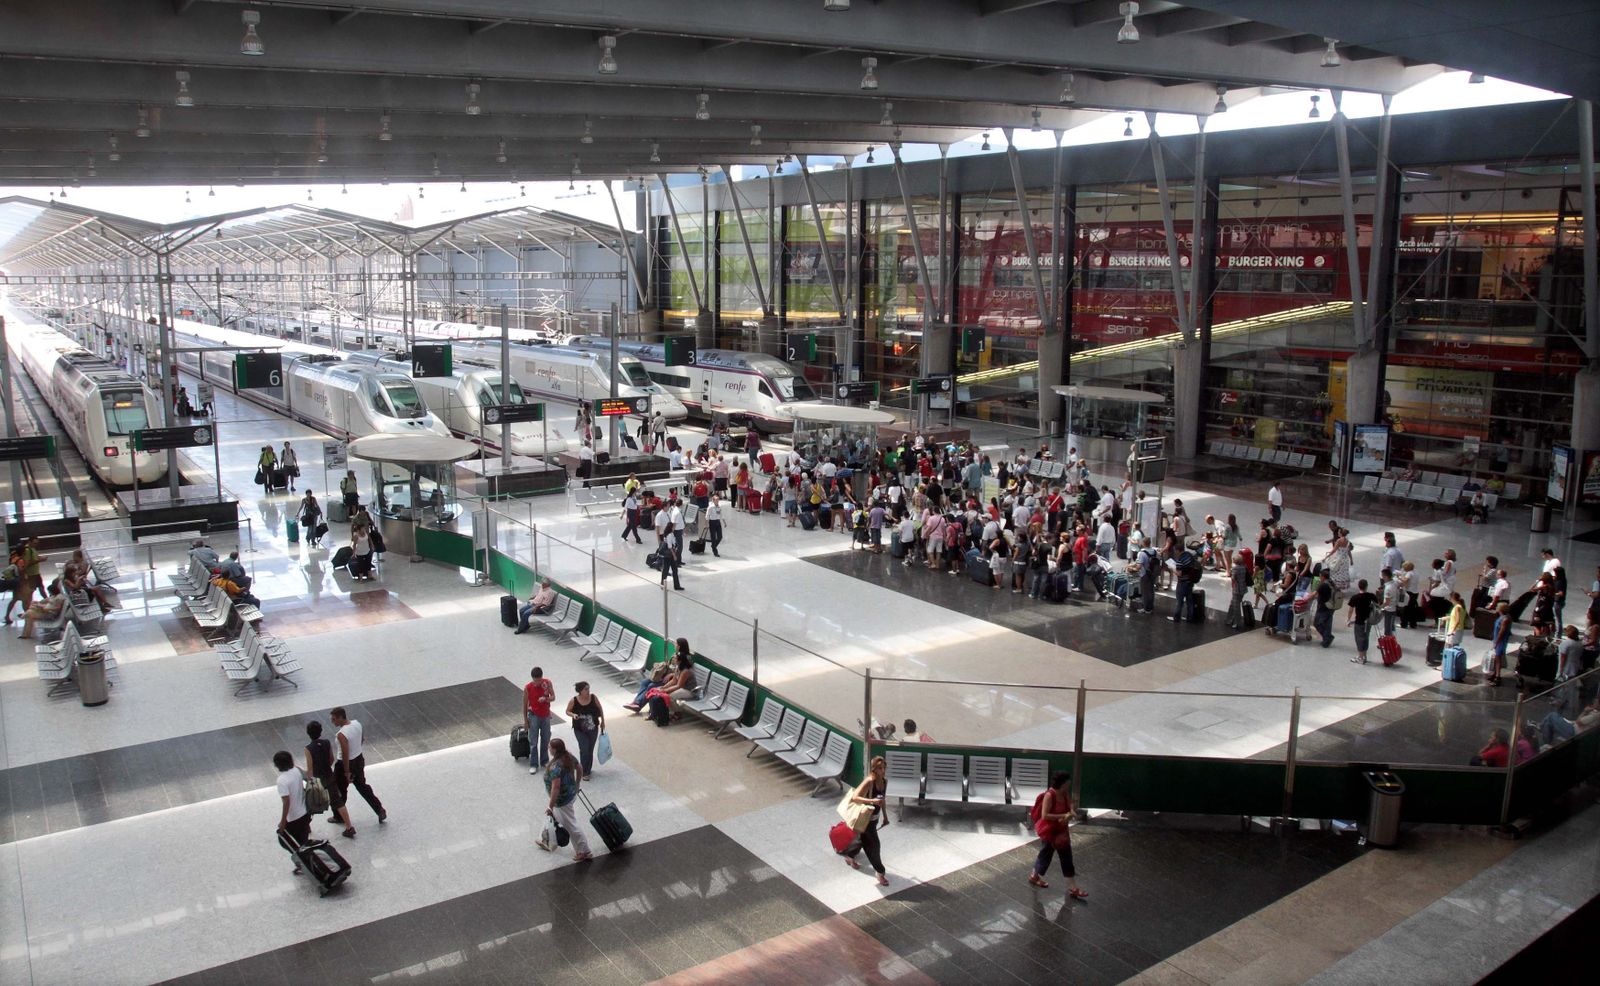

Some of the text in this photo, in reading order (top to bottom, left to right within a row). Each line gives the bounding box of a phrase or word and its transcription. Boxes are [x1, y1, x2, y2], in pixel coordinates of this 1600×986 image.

[1109, 256, 1172, 267] BURGER KING
[1228, 256, 1304, 267] BURGER KING
[688, 351, 695, 365] 3
[788, 348, 796, 361] 2
[414, 362, 426, 377] 4
[269, 369, 281, 386] 6
[725, 380, 747, 395] renfe
